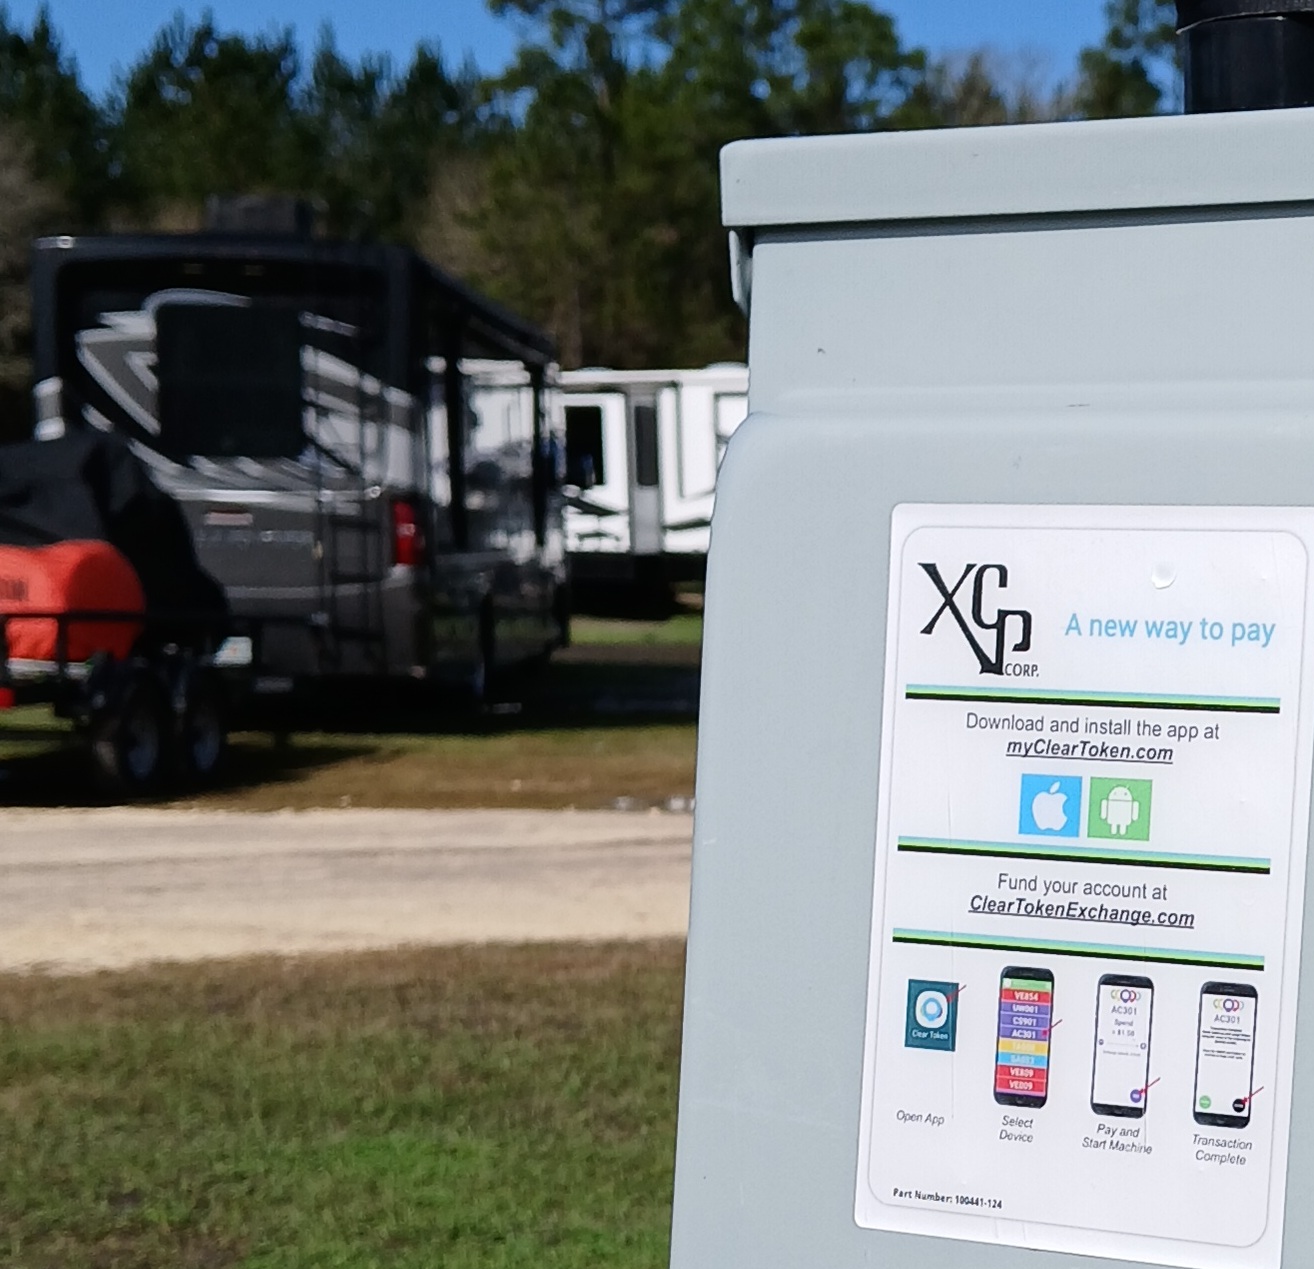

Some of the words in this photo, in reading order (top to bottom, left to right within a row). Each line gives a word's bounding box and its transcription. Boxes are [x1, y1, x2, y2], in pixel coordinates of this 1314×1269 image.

[1065, 613, 1082, 636] A
[1089, 617, 1137, 638] new
[1145, 619, 1193, 645] way
[1200, 618, 1224, 640] to
[1231, 621, 1276, 648] pay
[1004, 662, 1040, 678] CORP.
[966, 712, 1044, 732] Download
[1050, 717, 1079, 733] and
[1085, 718, 1131, 736] install
[1137, 720, 1162, 737] the
[1167, 723, 1199, 743] app
[1203, 723, 1220, 740] at
[1006, 738, 1174, 764] myClearToken.com
[998, 873, 1037, 892] Fund
[1042, 879, 1078, 896] your
[1083, 881, 1147, 900] account
[1152, 884, 1168, 900] at
[968, 894, 1195, 929] ClearTokenExchange.com
[896, 1109, 923, 1124] Open
[924, 1112, 945, 1127] App
[1001, 1115, 1034, 1129] Select
[999, 1129, 1034, 1143] Device
[1096, 1123, 1118, 1138] Pay
[1119, 1126, 1140, 1138] and
[1081, 1136, 1107, 1150] Start
[1108, 1139, 1153, 1155] Machine
[1192, 1133, 1253, 1151] Transaction
[1195, 1149, 1247, 1166] Complete
[892, 1187, 912, 1199] Part
[914, 1189, 953, 1204] Number:
